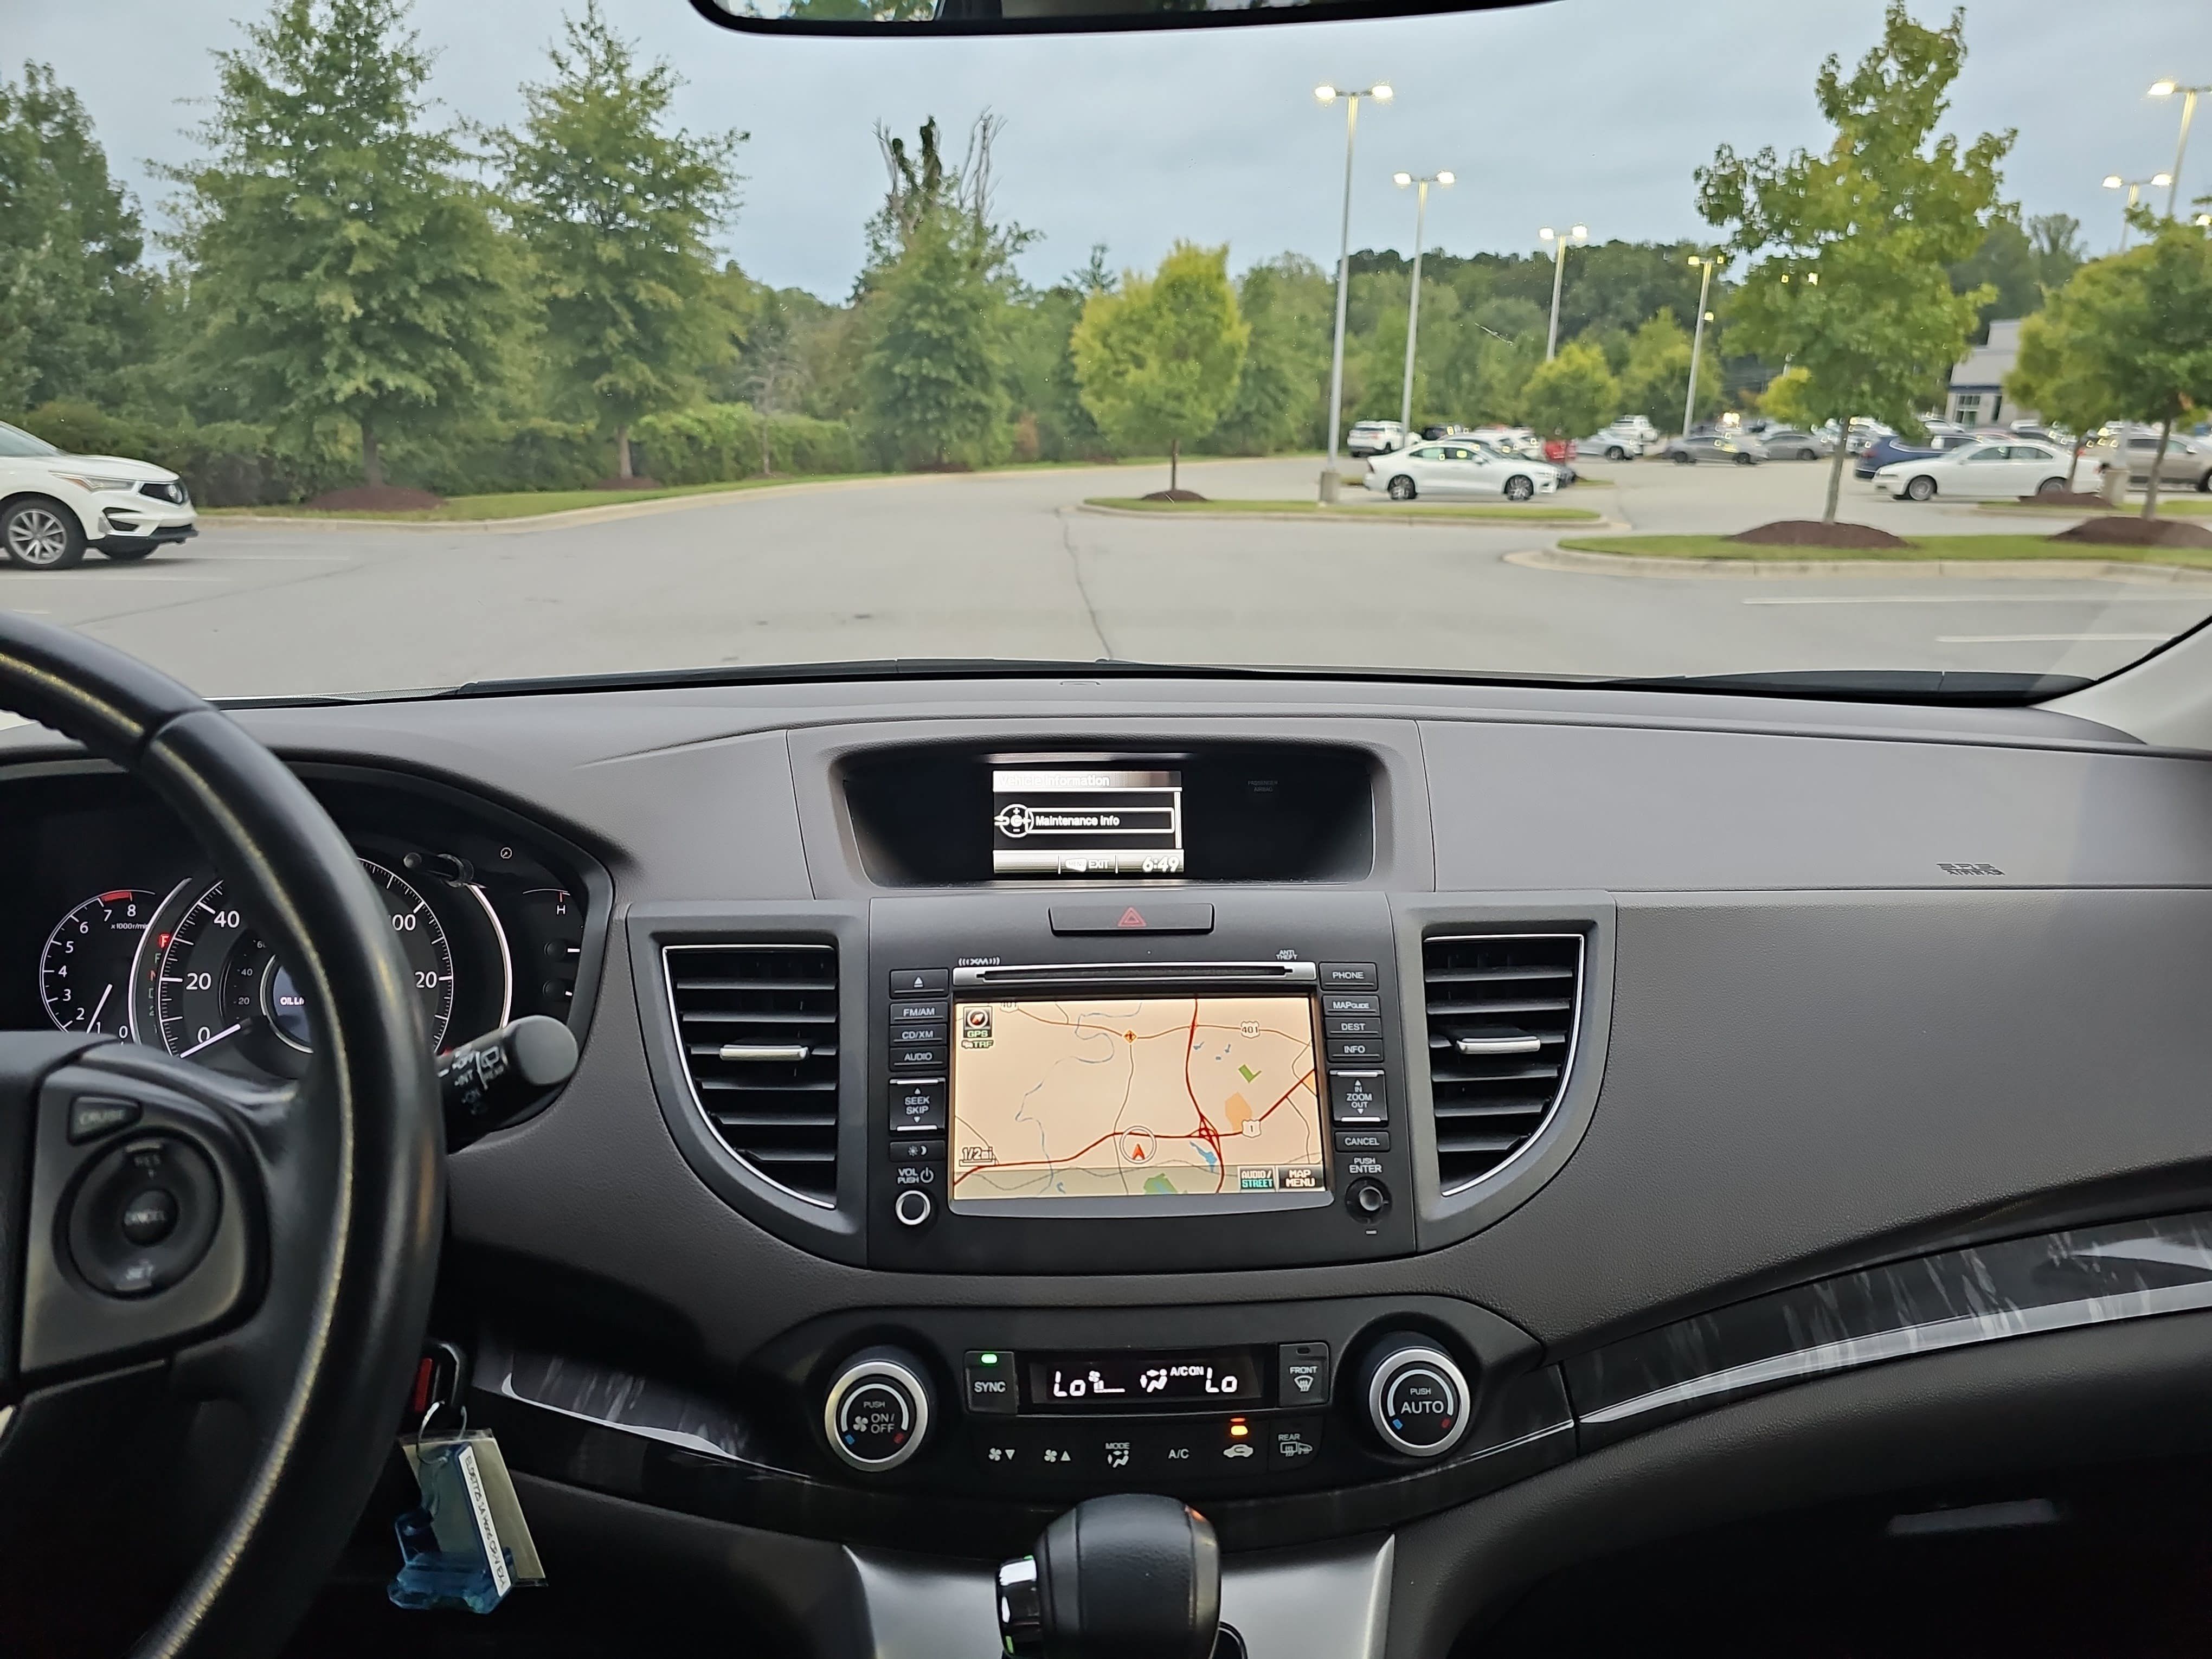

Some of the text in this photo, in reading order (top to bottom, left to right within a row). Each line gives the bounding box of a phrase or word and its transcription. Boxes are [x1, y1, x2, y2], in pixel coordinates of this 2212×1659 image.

[999, 774, 1110, 786] Vehicle Information
[1035, 815, 1121, 826] Maintenance Info
[1088, 859, 1110, 869] EXIT
[1142, 855, 1180, 872] 6:49
[127, 904, 136, 917] 8
[556, 904, 565, 915] H
[104, 909, 112, 922] 7
[214, 910, 240, 928] 40
[392, 914, 416, 931] 00
[79, 923, 89, 934] 6
[65, 941, 74, 954] 5
[58, 965, 68, 978] 4
[1332, 971, 1365, 979] PHONE
[185, 973, 212, 991] 20
[415, 971, 438, 988] 20
[63, 988, 71, 1002] 3
[238, 996, 250, 1005] 20
[75, 1007, 85, 1020] 2
[903, 1007, 935, 1017] FM/AM
[118, 1025, 128, 1039] 0
[1341, 1023, 1366, 1031] DEST
[197, 1026, 210, 1043] 0
[902, 1030, 934, 1039] CD/XM
[973, 1040, 994, 1049] TRF
[1343, 1045, 1366, 1053] INFO
[904, 1052, 933, 1061] AUDIO
[904, 1096, 930, 1105] SEEK
[1346, 1093, 1372, 1102] ZOOM
[906, 1106, 929, 1115] SKIP
[1345, 1137, 1380, 1146] CANCEL
[898, 1168, 918, 1176] VOL
[1289, 1169, 1311, 1178] MAP
[1349, 1165, 1382, 1174] ENTER
[1241, 1179, 1273, 1188] STREET
[1285, 1178, 1316, 1187] MENU
[1169, 1366, 1188, 1376] A/C
[1289, 1366, 1318, 1374] FRONT
[974, 1381, 1006, 1393] SYNC
[1400, 1401, 1444, 1414] AUTO
[870, 1424, 895, 1434] OFF
[1168, 1449, 1190, 1459] A/C
